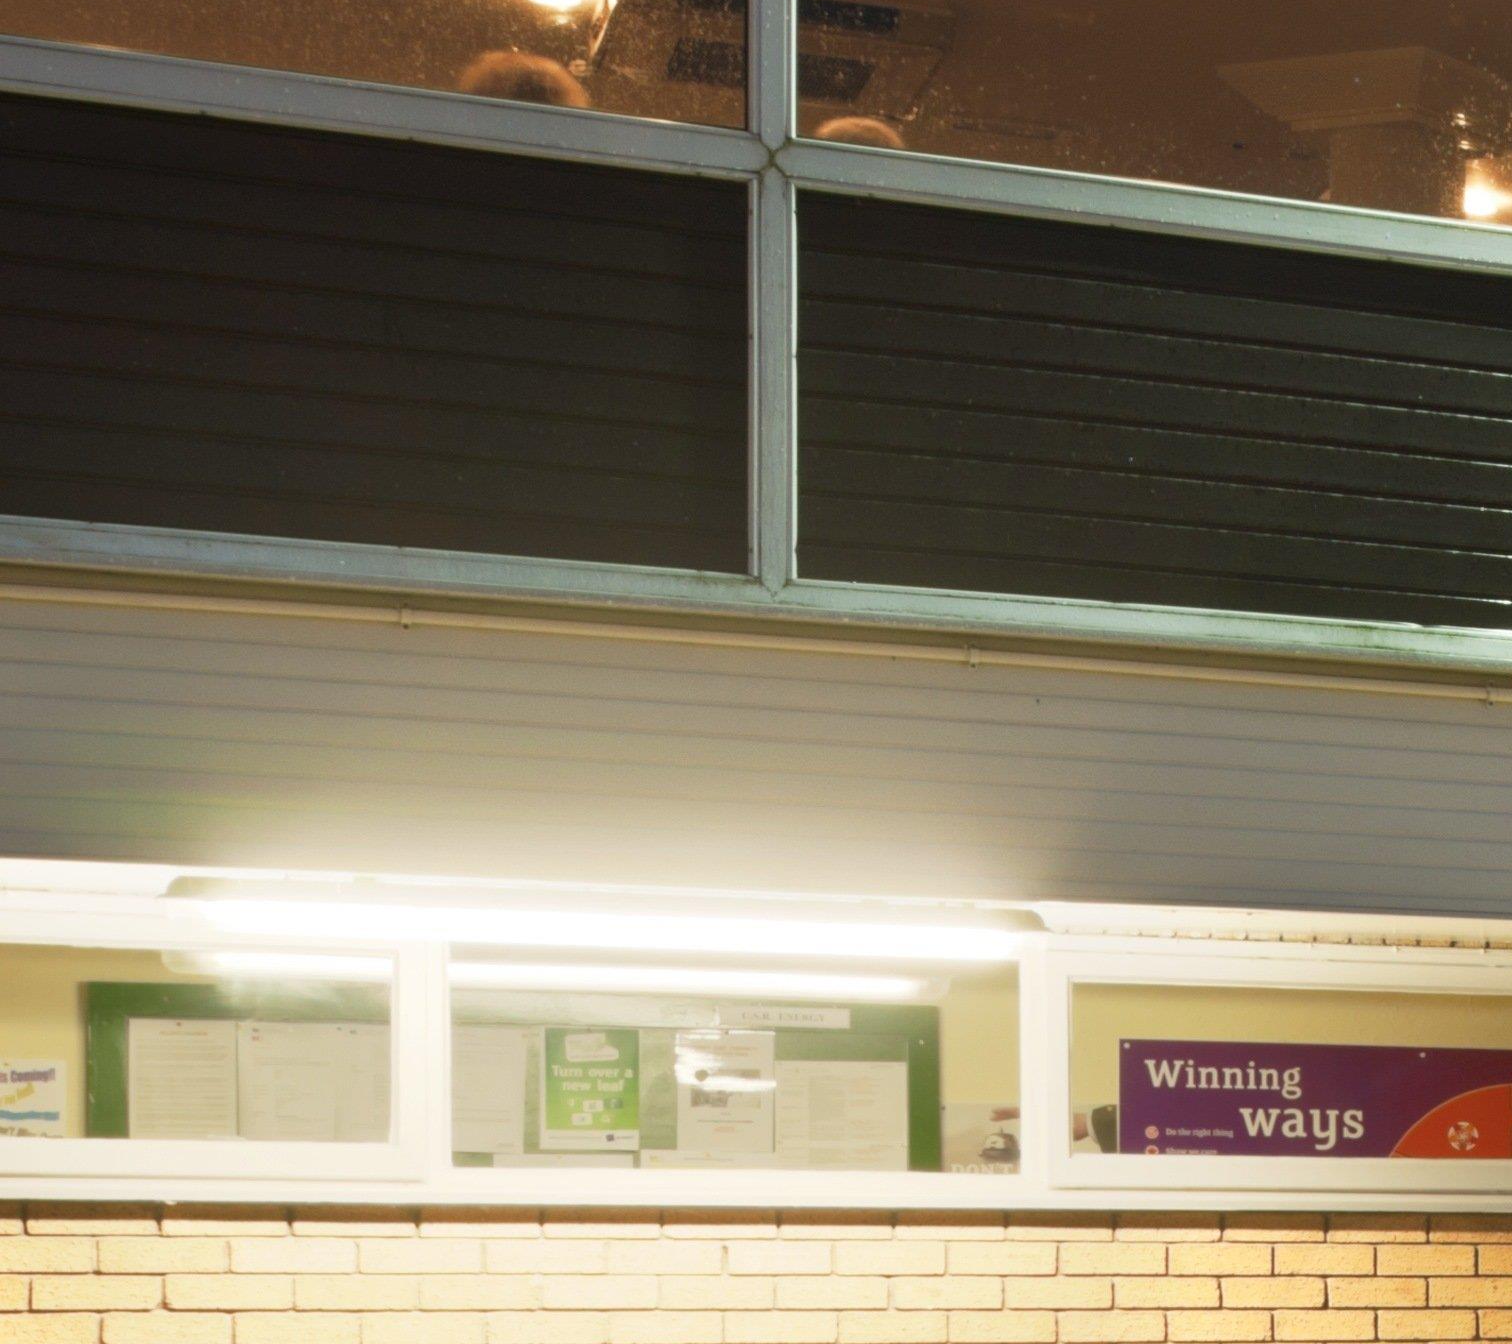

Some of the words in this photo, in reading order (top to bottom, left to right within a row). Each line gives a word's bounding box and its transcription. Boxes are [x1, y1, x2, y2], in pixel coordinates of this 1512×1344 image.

[551, 1064, 583, 1077] Turn
[588, 1067, 620, 1078] over
[624, 1067, 634, 1079] a
[1143, 1058, 1303, 1100] Winning
[562, 1080, 592, 1091] new
[597, 1078, 625, 1092] leaf
[1165, 1127, 1177, 1136] Do
[1177, 1127, 1191, 1136] the
[1192, 1128, 1212, 1138] right
[1212, 1128, 1234, 1139] thing
[1238, 1106, 1365, 1151] ways
